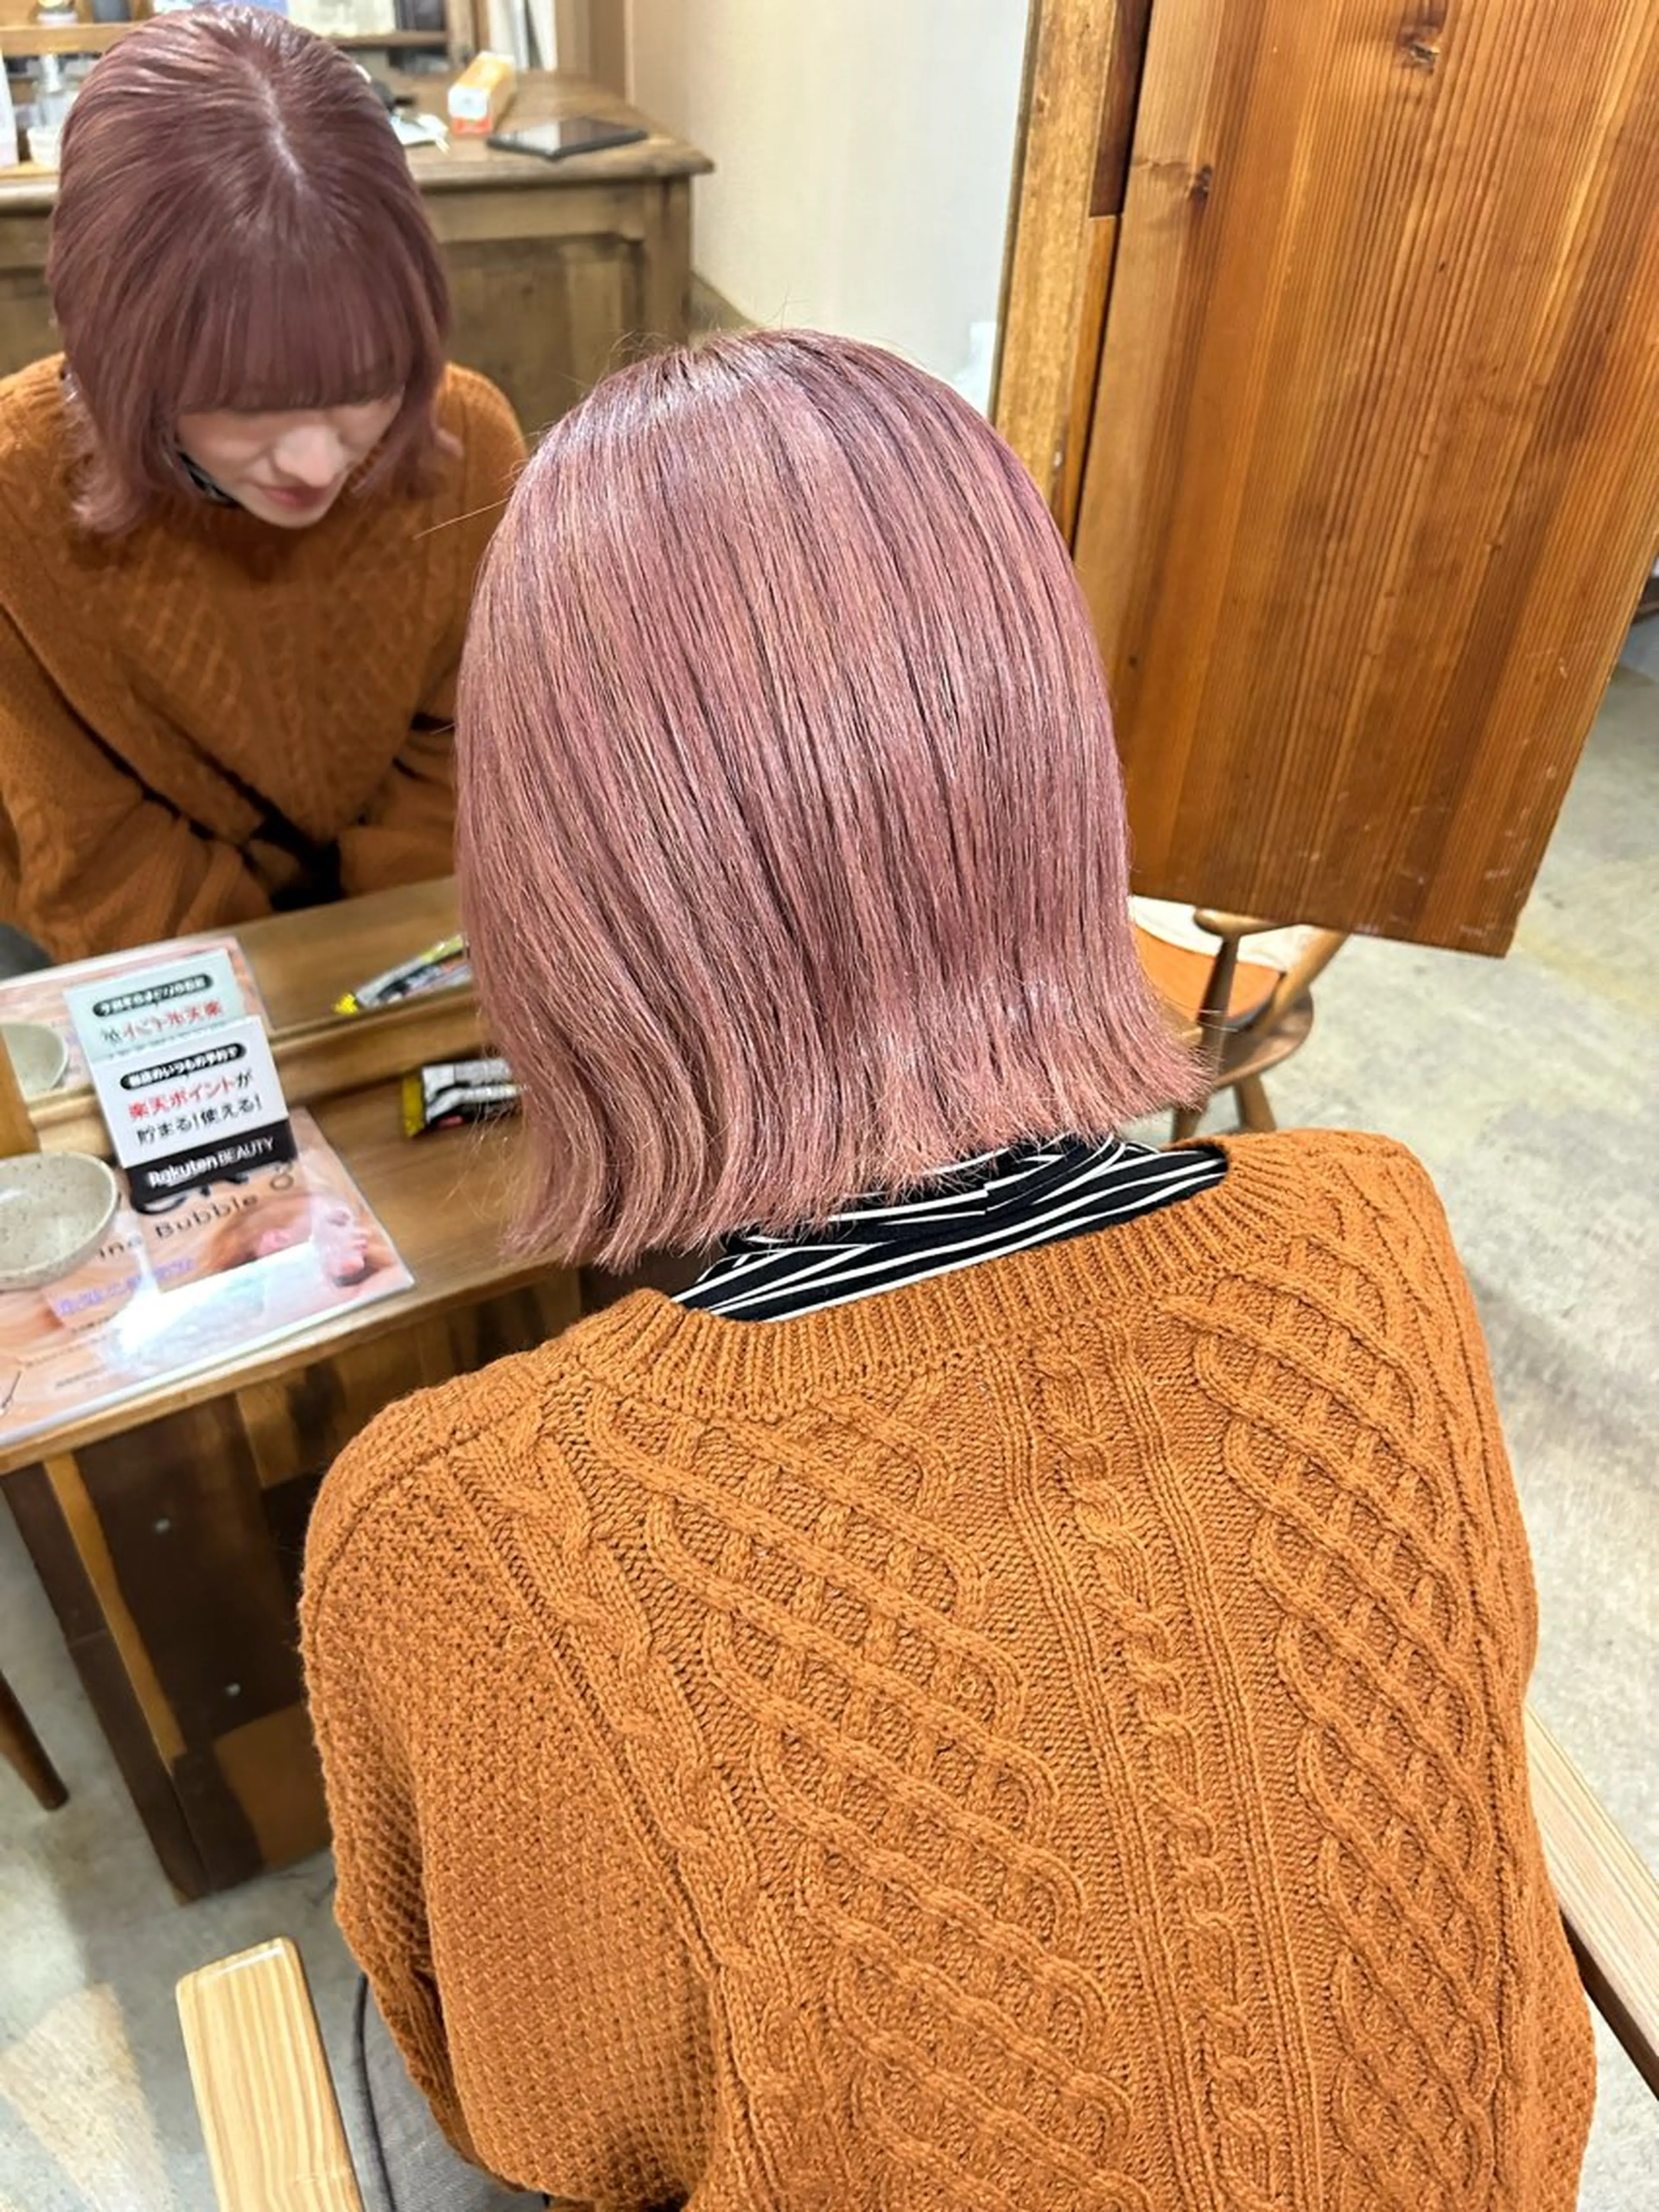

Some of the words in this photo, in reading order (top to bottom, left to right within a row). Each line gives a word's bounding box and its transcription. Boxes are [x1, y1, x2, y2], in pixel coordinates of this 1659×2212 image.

[128, 1069, 252, 1119] 楽天ポイントが
[148, 1154, 219, 1188] Rakuten
[217, 1136, 274, 1166] BEAUTY
[155, 1194, 258, 1239] Bubble
